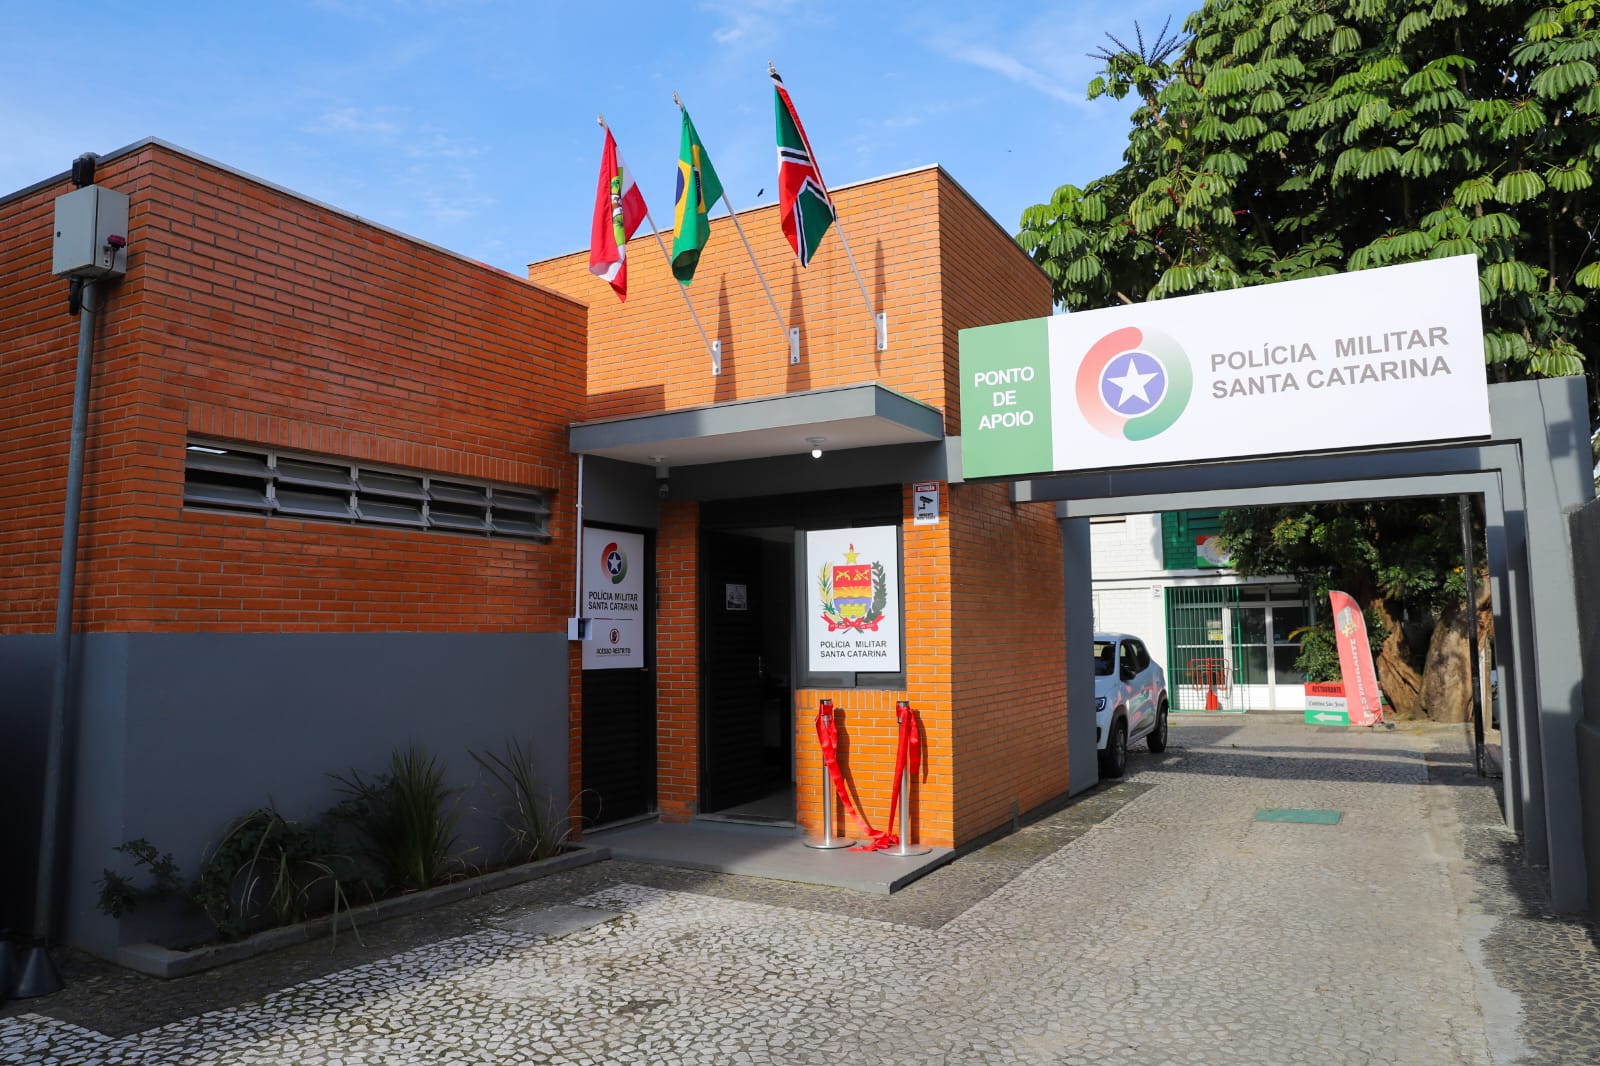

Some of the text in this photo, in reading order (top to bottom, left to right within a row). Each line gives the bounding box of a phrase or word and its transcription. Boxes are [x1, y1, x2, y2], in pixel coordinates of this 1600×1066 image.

[1210, 326, 1449, 372] POLÍCIA MILITAR
[974, 366, 1035, 388] PONTO
[1212, 355, 1452, 399] SANTA CATARINA
[993, 390, 1017, 407] DE
[978, 410, 1034, 431] APOIO
[614, 592, 638, 601] MILITAR
[588, 601, 639, 611] SANTA CATARINA
[855, 640, 887, 648] MILITAR
[820, 650, 888, 658] SANTA CATARINA
